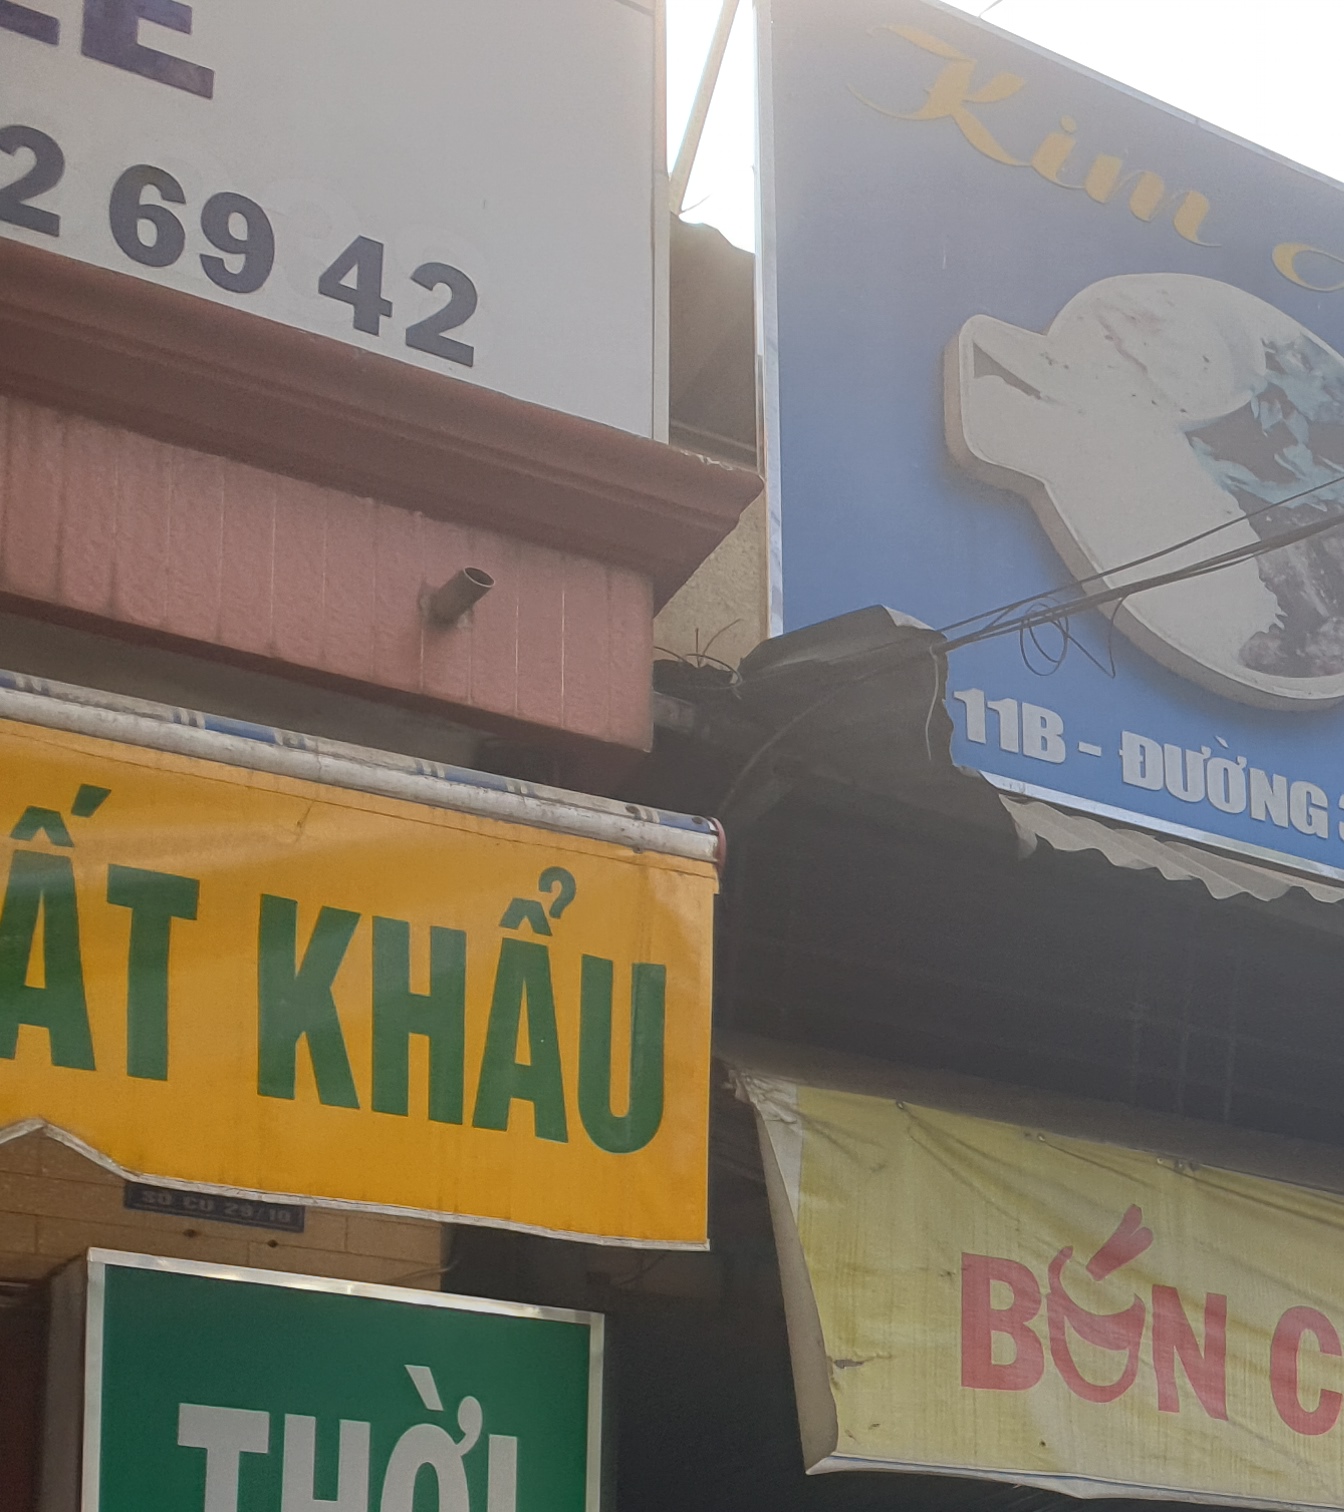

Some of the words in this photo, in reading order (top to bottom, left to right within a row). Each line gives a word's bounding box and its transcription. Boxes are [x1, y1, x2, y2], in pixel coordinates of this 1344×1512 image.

[846, 24, 1222, 247] Kim
[954, 688, 1066, 764] 11B
[1119, 731, 1329, 839] ĐƯỜNG
[257, 867, 667, 1154] KHẨU
